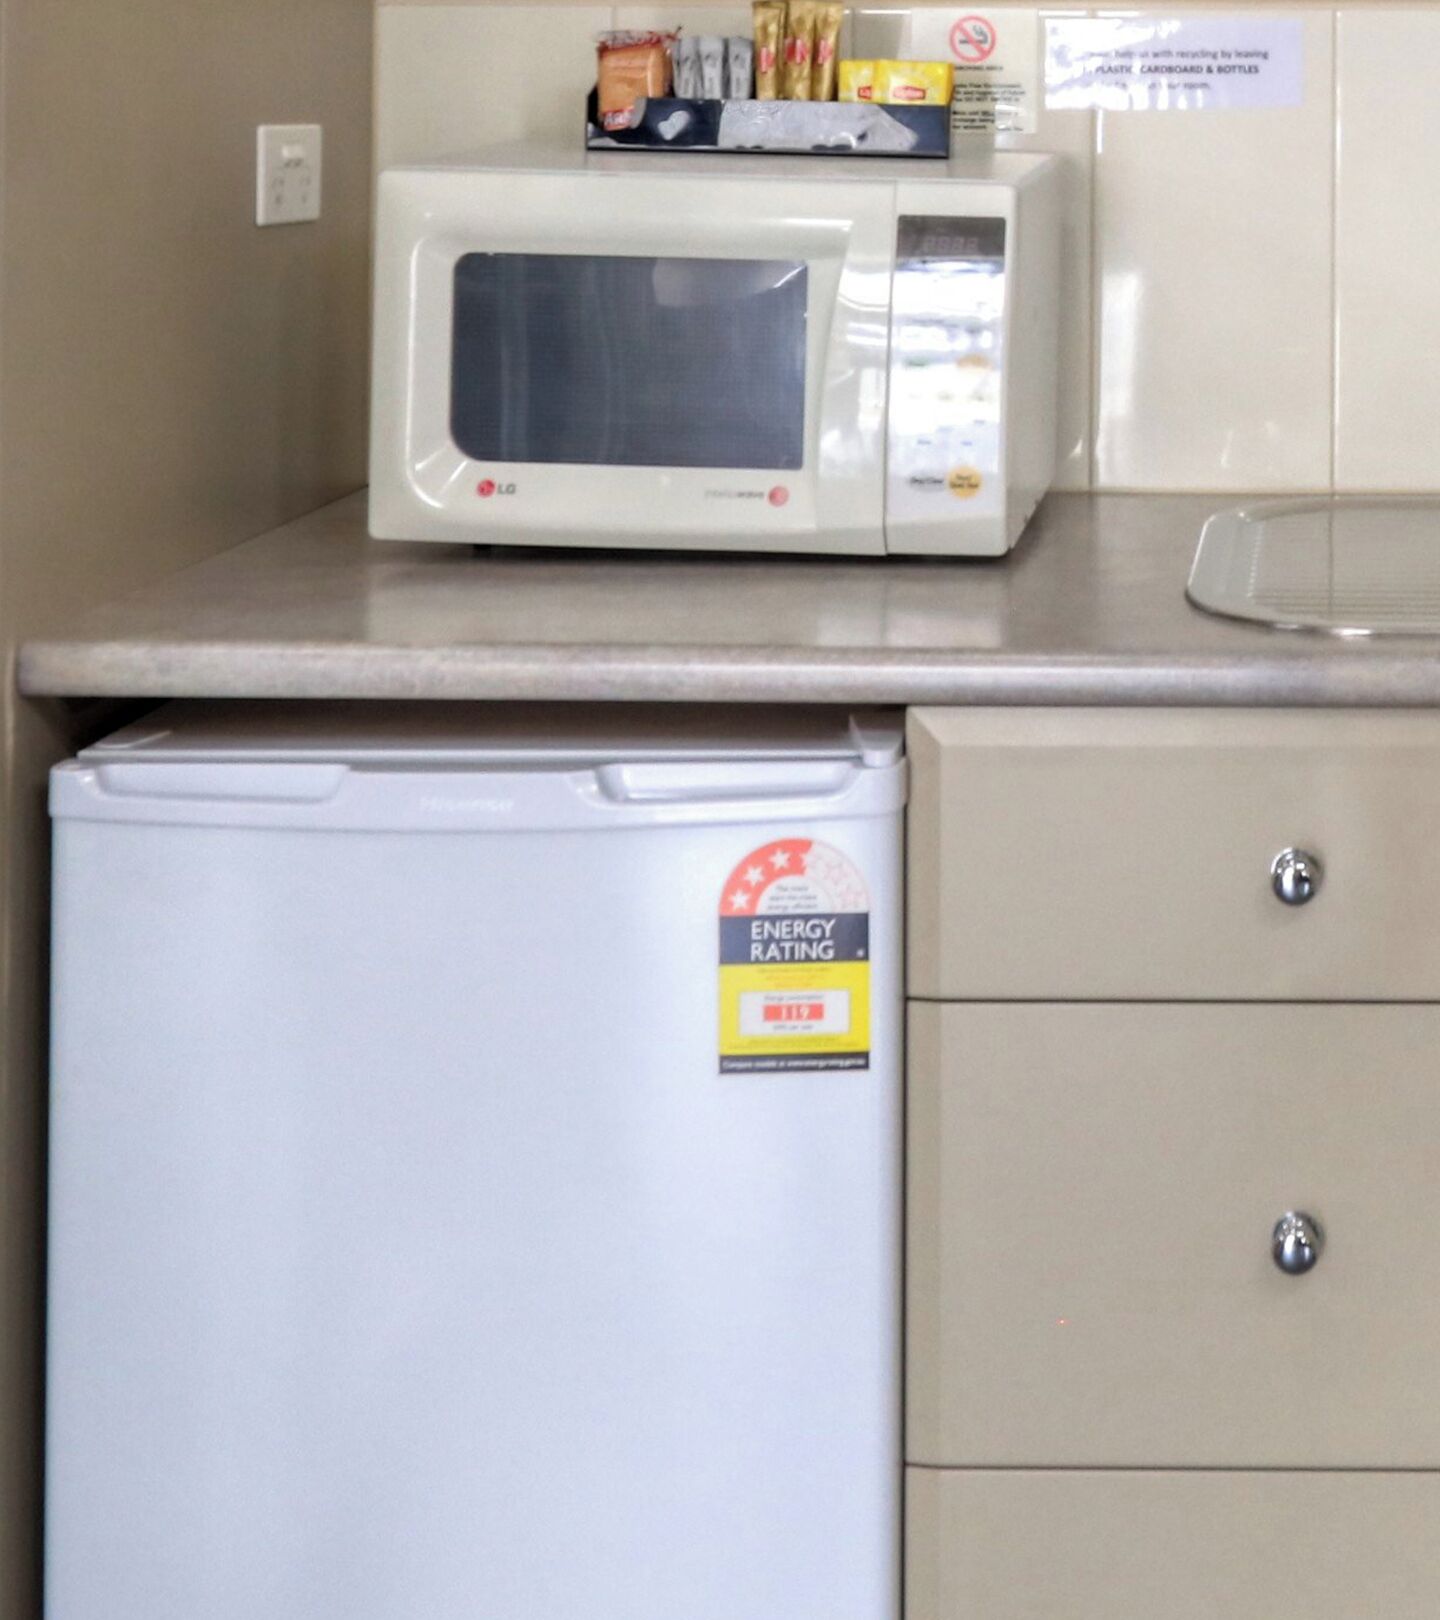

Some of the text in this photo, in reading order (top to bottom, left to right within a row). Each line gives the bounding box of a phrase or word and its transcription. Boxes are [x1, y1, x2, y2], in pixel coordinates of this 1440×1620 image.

[1152, 49, 1174, 59] with
[1176, 49, 1218, 61] recycling
[1220, 49, 1232, 61] by
[1235, 49, 1269, 61] leaving
[1140, 65, 1203, 75] CARDBOARD
[1206, 65, 1213, 75] &
[1217, 65, 1259, 75] BOTTLES
[497, 483, 516, 495] LG
[751, 918, 836, 940] ENERGY
[751, 940, 835, 962] RATING
[781, 1005, 810, 1020] 119
